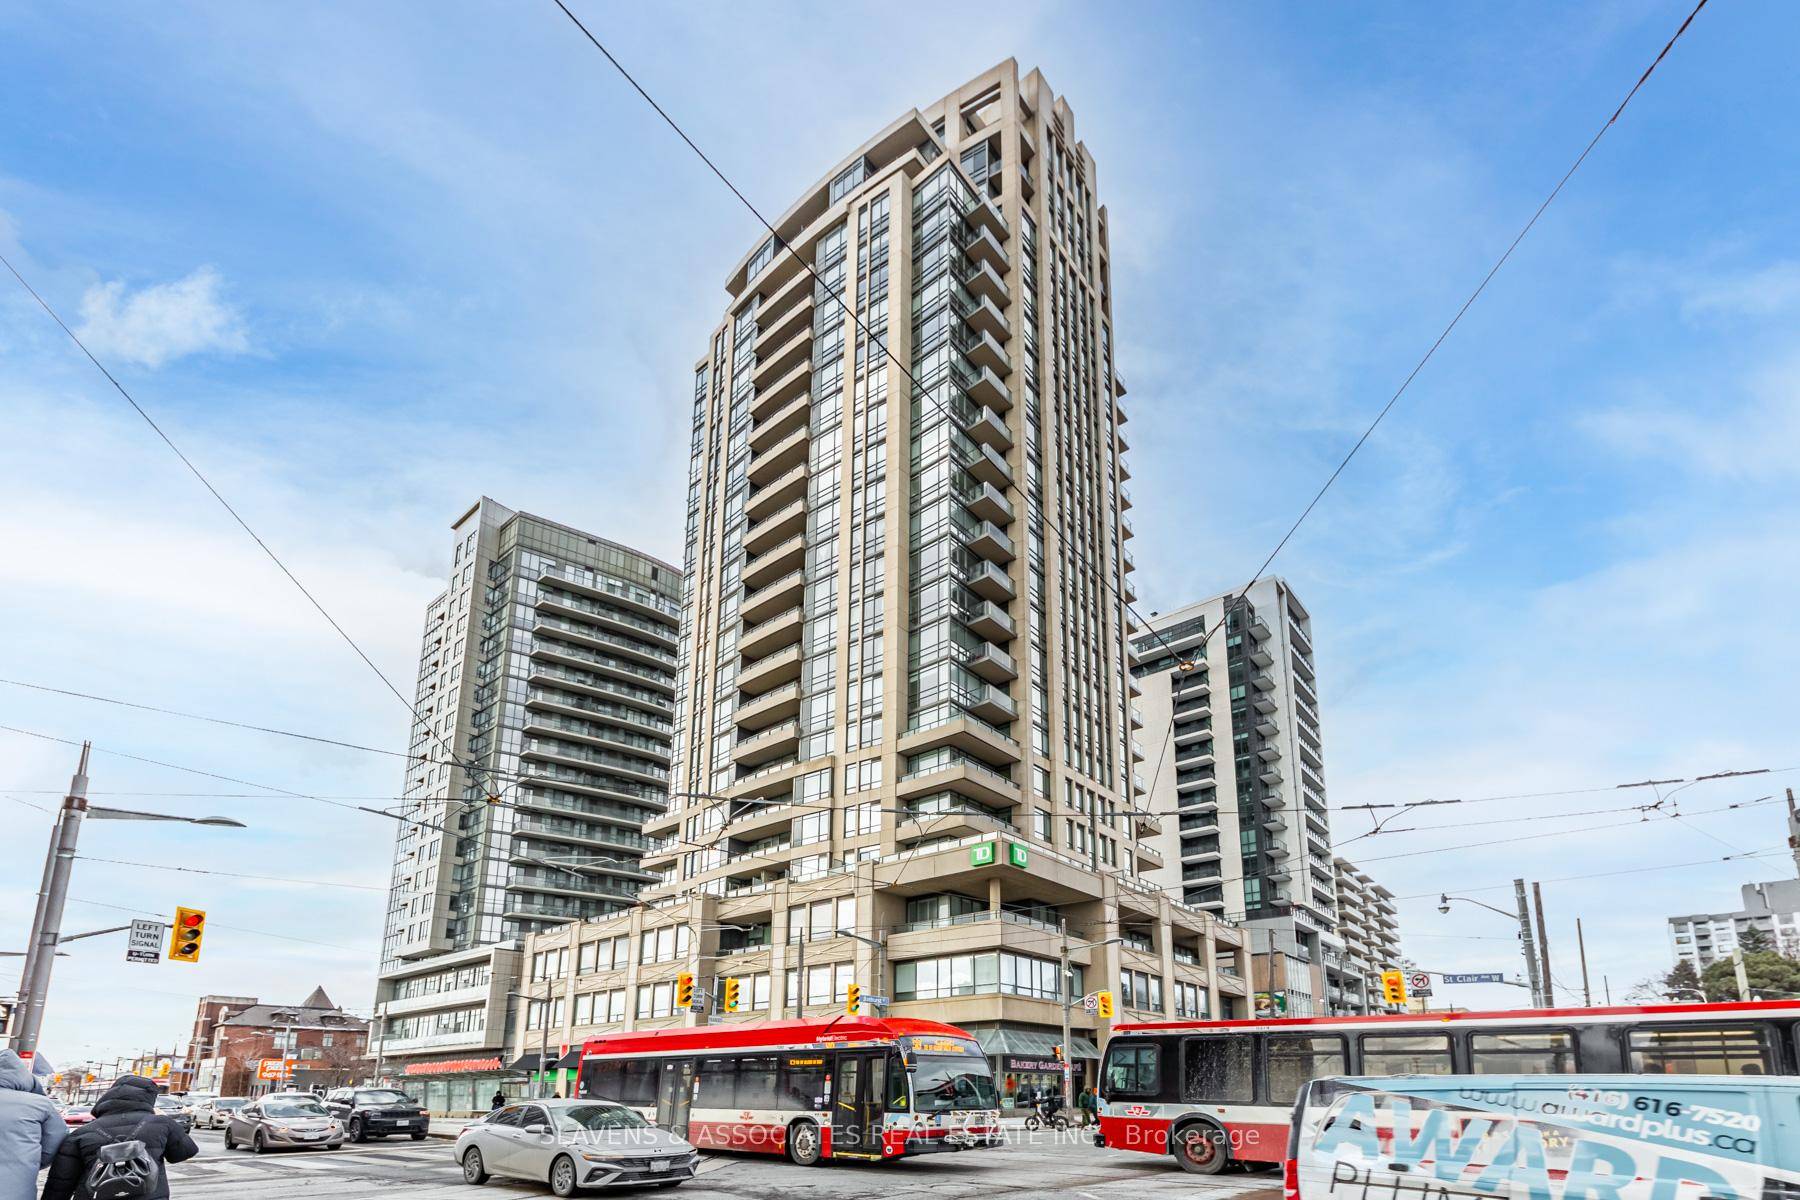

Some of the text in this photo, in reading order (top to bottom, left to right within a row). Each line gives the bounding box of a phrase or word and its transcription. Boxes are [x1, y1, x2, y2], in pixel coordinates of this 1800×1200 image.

[973, 846, 990, 861] TD
[1014, 847, 1027, 863] TD
[136, 923, 159, 931] LEFT
[135, 931, 160, 940] TURN
[131, 940, 159, 948] SIGNAL
[1444, 975, 1453, 983] St
[1456, 975, 1479, 983] Clair
[1491, 974, 1500, 982] W
[1010, 1059, 1037, 1069] BAKERY
[1633, 1095, 1762, 1132] 616-7520
